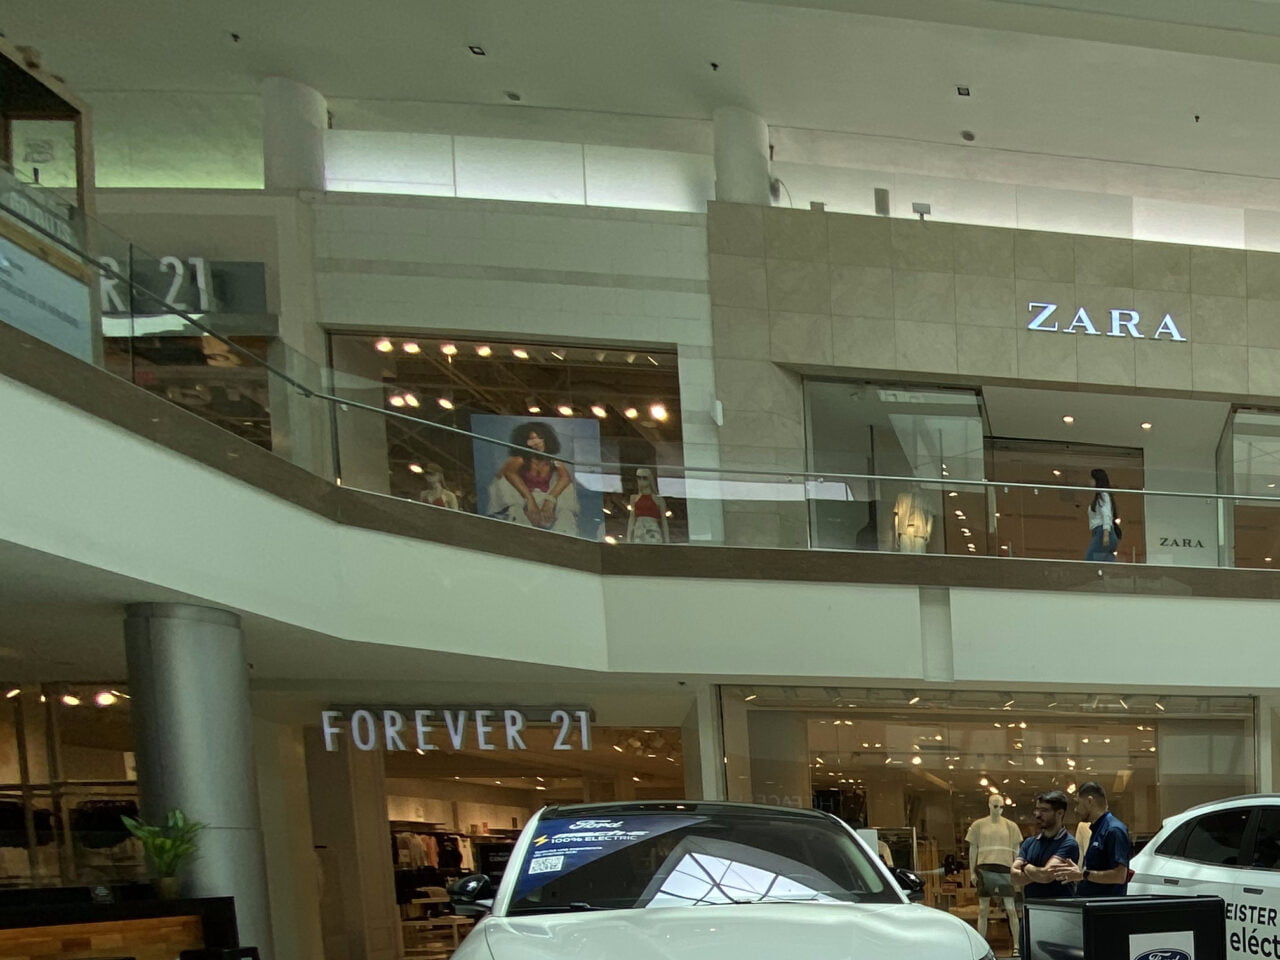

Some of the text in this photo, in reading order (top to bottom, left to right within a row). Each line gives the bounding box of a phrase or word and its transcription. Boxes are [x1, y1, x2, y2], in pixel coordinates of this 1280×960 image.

[160, 256, 209, 313] 21
[1027, 302, 1187, 341] ZARA
[1160, 537, 1204, 548] ZARA
[321, 710, 591, 751] FOREVER 21
[569, 820, 624, 829] Ford
